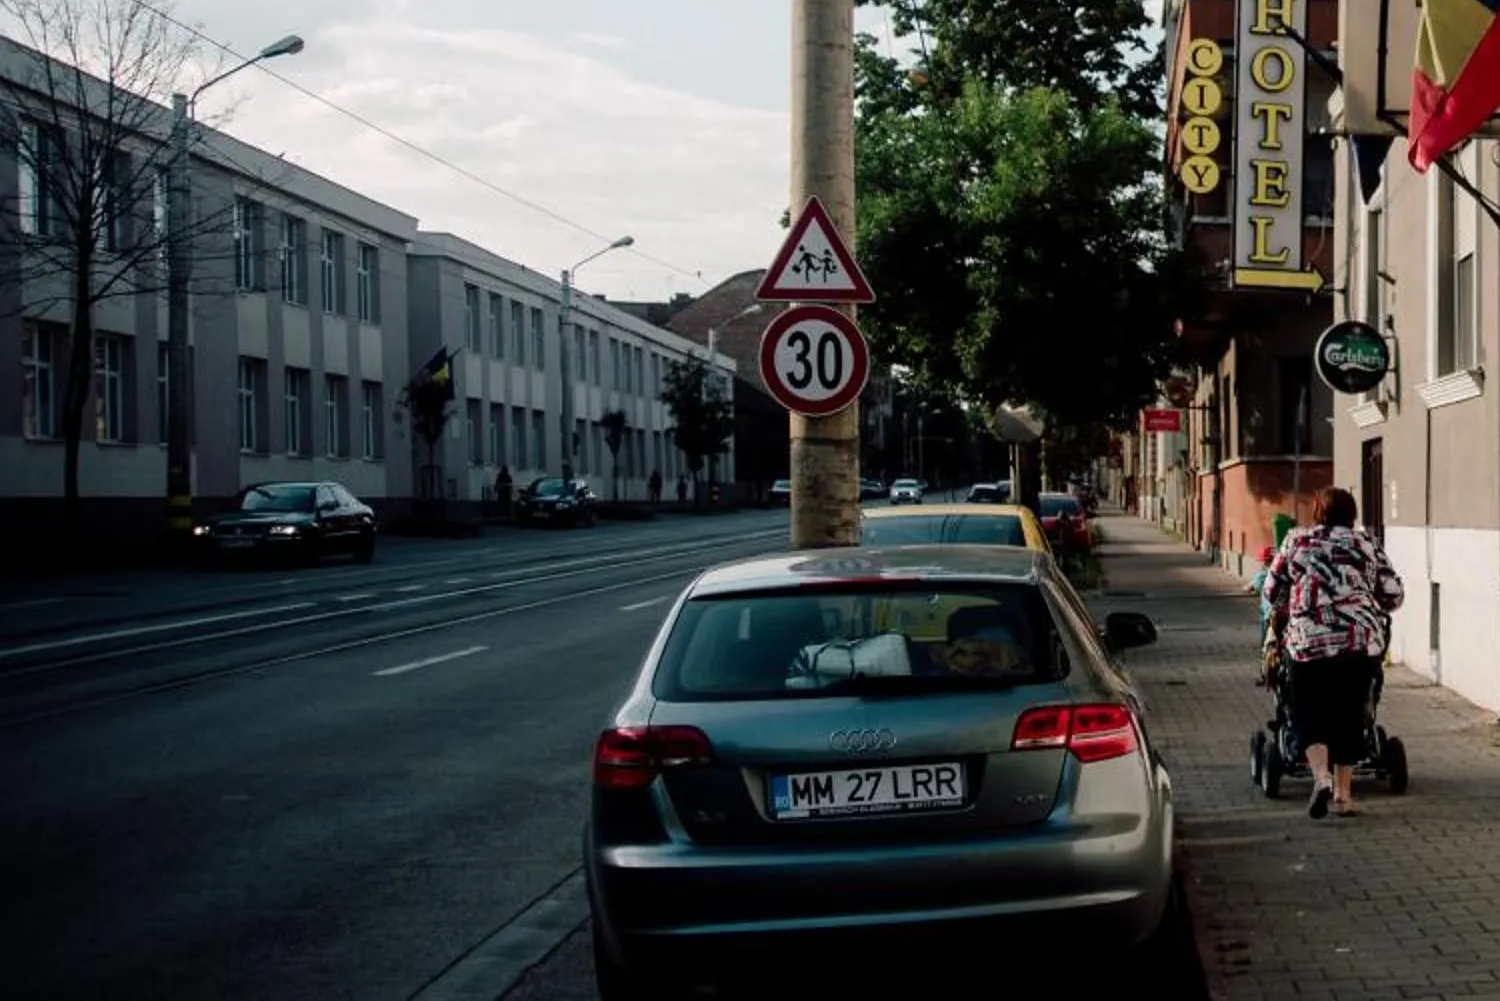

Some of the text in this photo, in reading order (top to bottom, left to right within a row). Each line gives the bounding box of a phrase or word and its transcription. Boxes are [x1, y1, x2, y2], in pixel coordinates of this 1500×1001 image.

[1187, 42, 1216, 190] CITY
[785, 330, 843, 390] 30
[1324, 343, 1386, 369] Carlsberg
[790, 774, 835, 807] MM
[846, 770, 883, 803] 27
[891, 766, 958, 800] LRR
